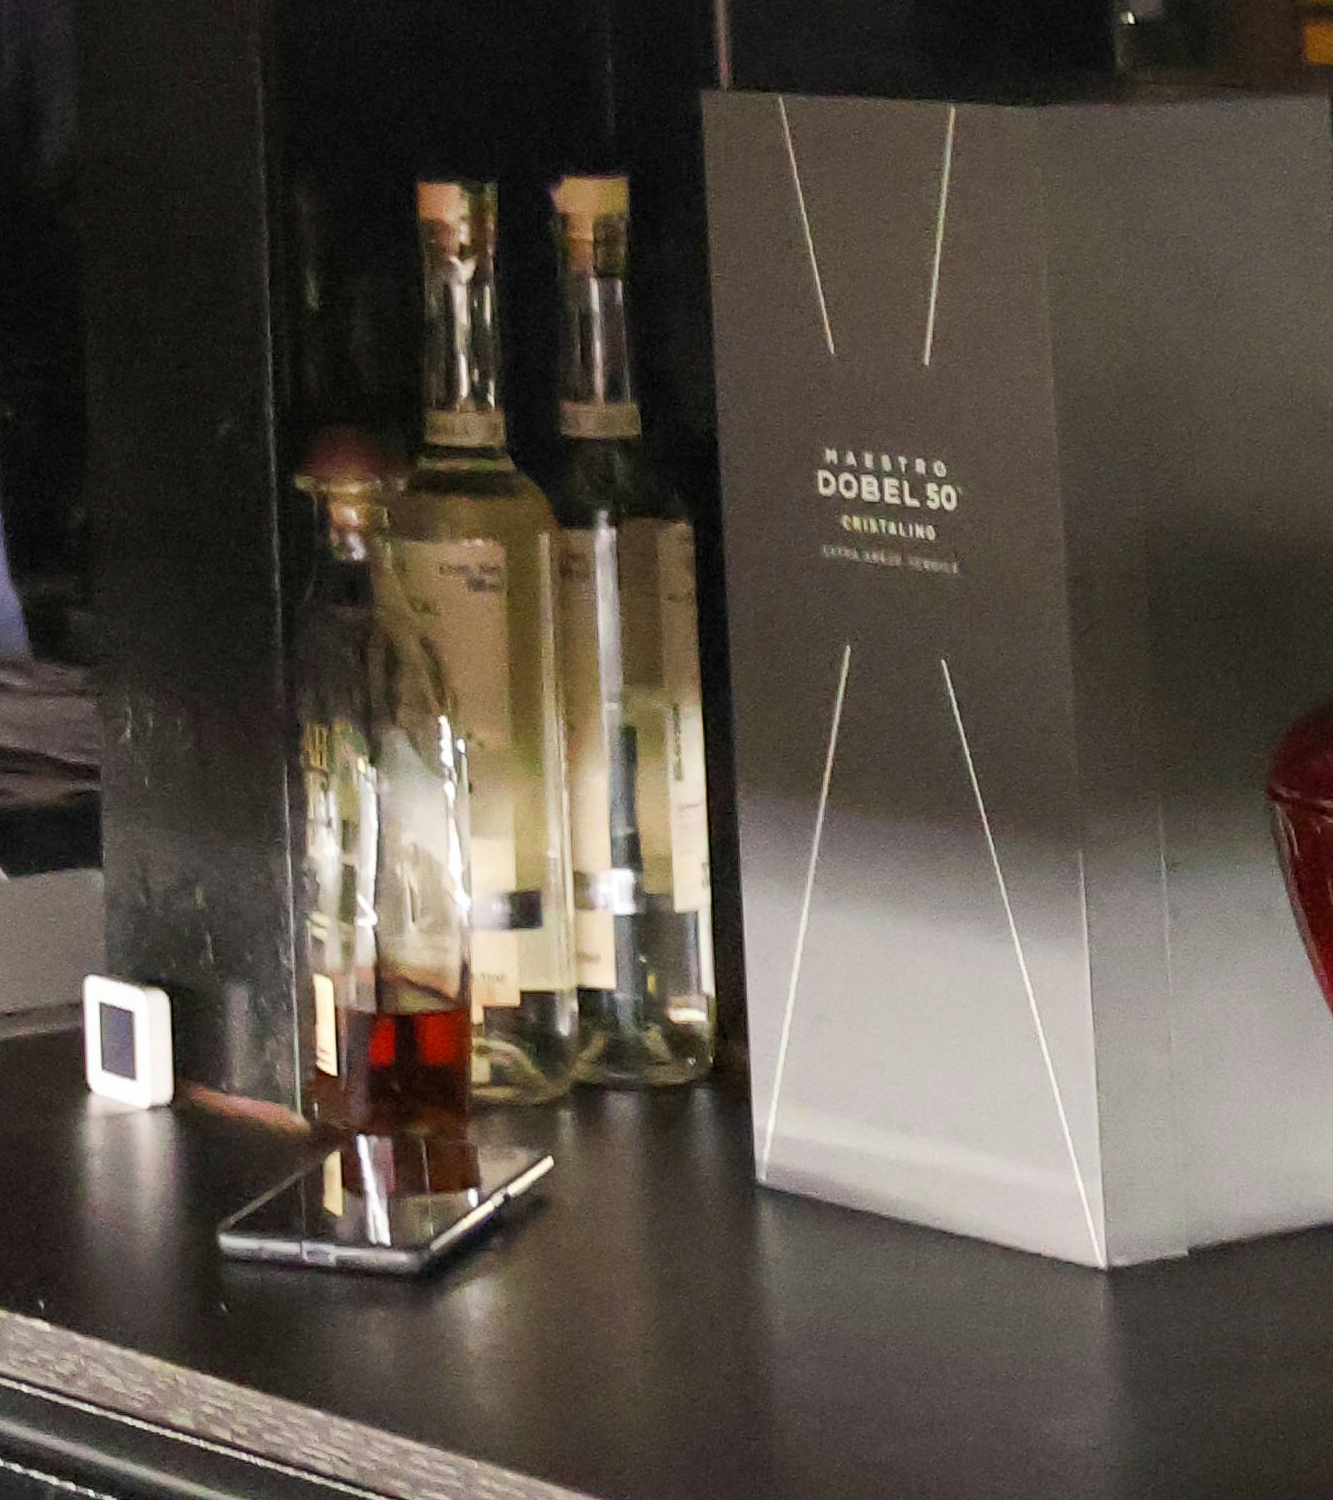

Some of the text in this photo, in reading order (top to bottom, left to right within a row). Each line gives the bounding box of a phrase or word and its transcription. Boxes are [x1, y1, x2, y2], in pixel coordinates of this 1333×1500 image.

[824, 447, 948, 479] MAESTRO
[817, 468, 959, 512] DOBEL 50
[840, 513, 937, 542] CRISTALINO
